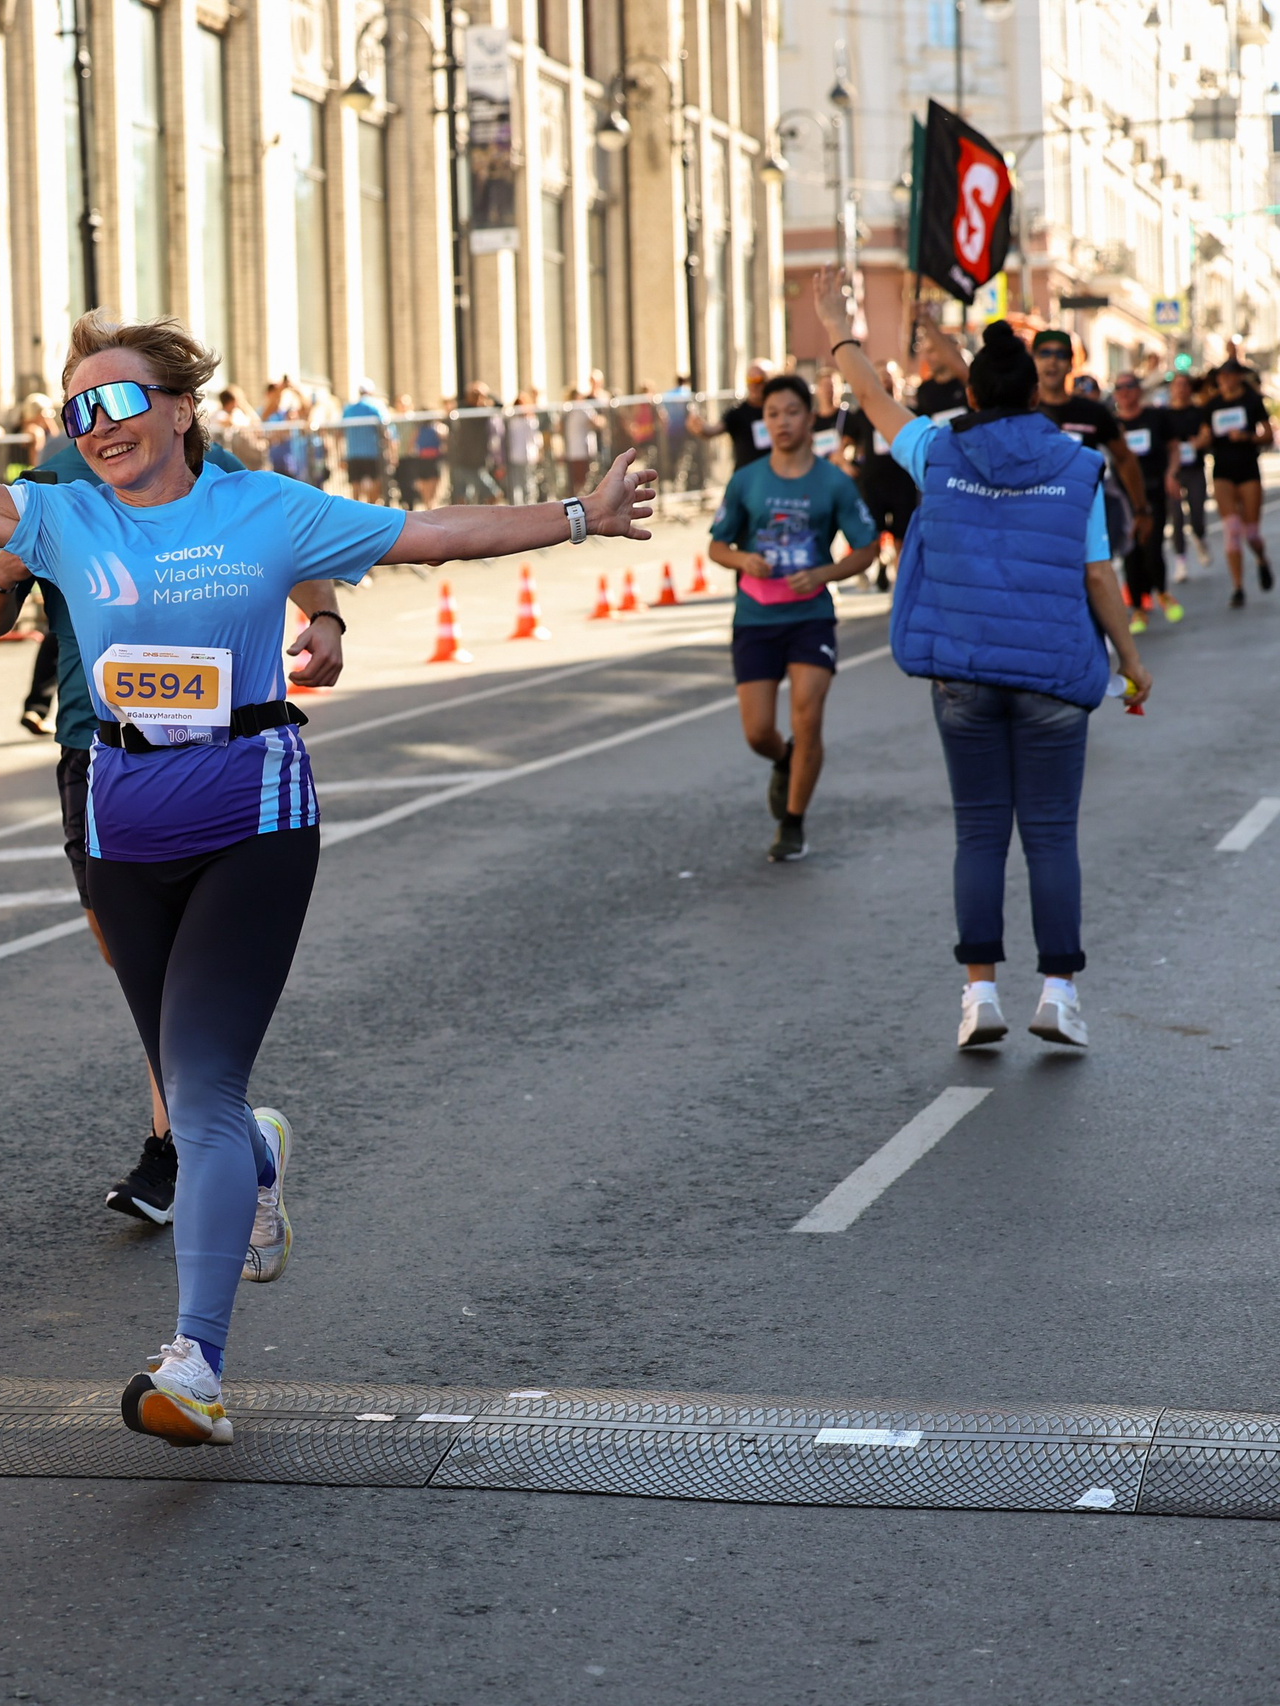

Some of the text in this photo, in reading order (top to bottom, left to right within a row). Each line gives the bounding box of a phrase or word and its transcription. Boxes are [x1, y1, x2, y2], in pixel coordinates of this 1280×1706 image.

[154, 544, 224, 563] Galaxy
[154, 561, 265, 584] Vladivostok
[153, 581, 249, 605] Marathon
[115, 672, 205, 700] 5594
[127, 711, 193, 720] #GalaxyMarathon
[167, 728, 213, 743] 10km
